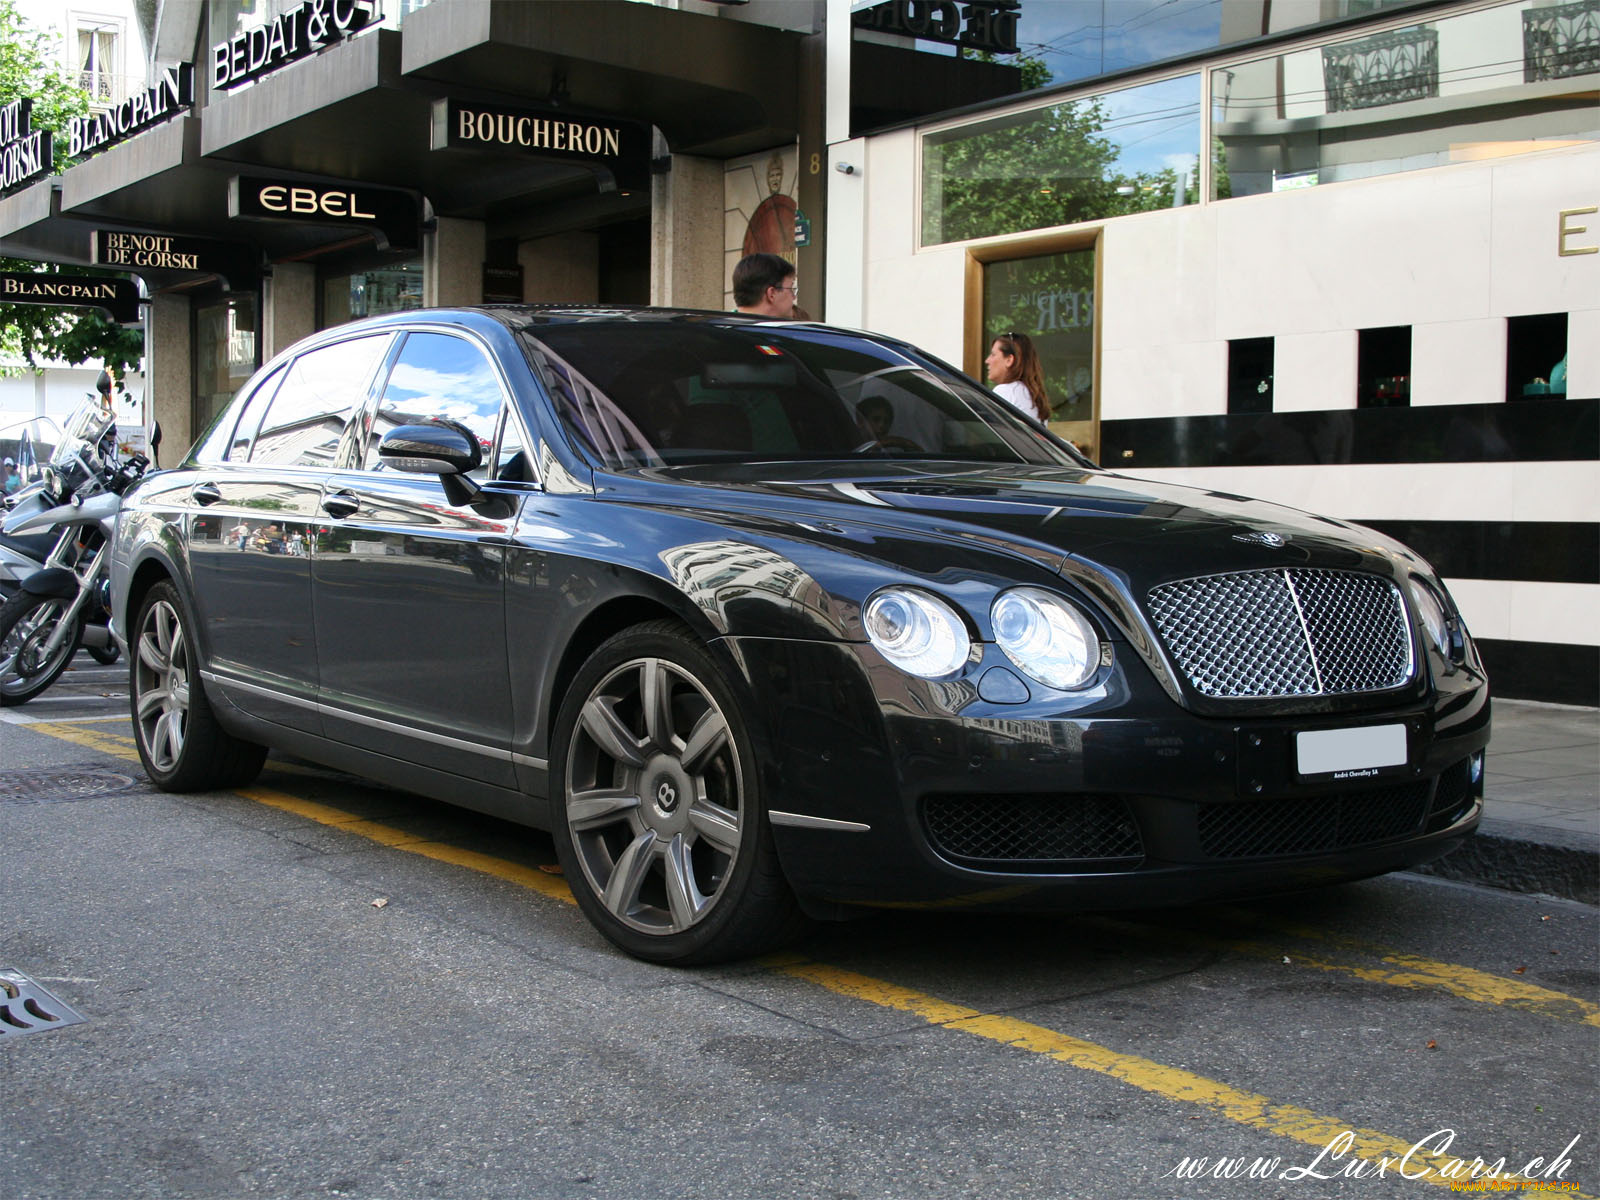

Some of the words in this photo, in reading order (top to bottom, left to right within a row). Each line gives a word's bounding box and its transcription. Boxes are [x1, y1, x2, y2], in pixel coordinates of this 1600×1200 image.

[212, 1, 304, 89] BEDAT
[308, 0, 329, 42] &
[69, 62, 183, 158] BLANCPAIN
[460, 110, 620, 156] BOUCHERON
[810, 153, 820, 175] 8
[260, 185, 375, 219] EBEL
[107, 233, 174, 253] BENOIT
[1560, 206, 1599, 256] E
[107, 249, 131, 265] DE
[135, 250, 199, 270] GORSKI
[4, 279, 117, 299] BLANCPAIN
